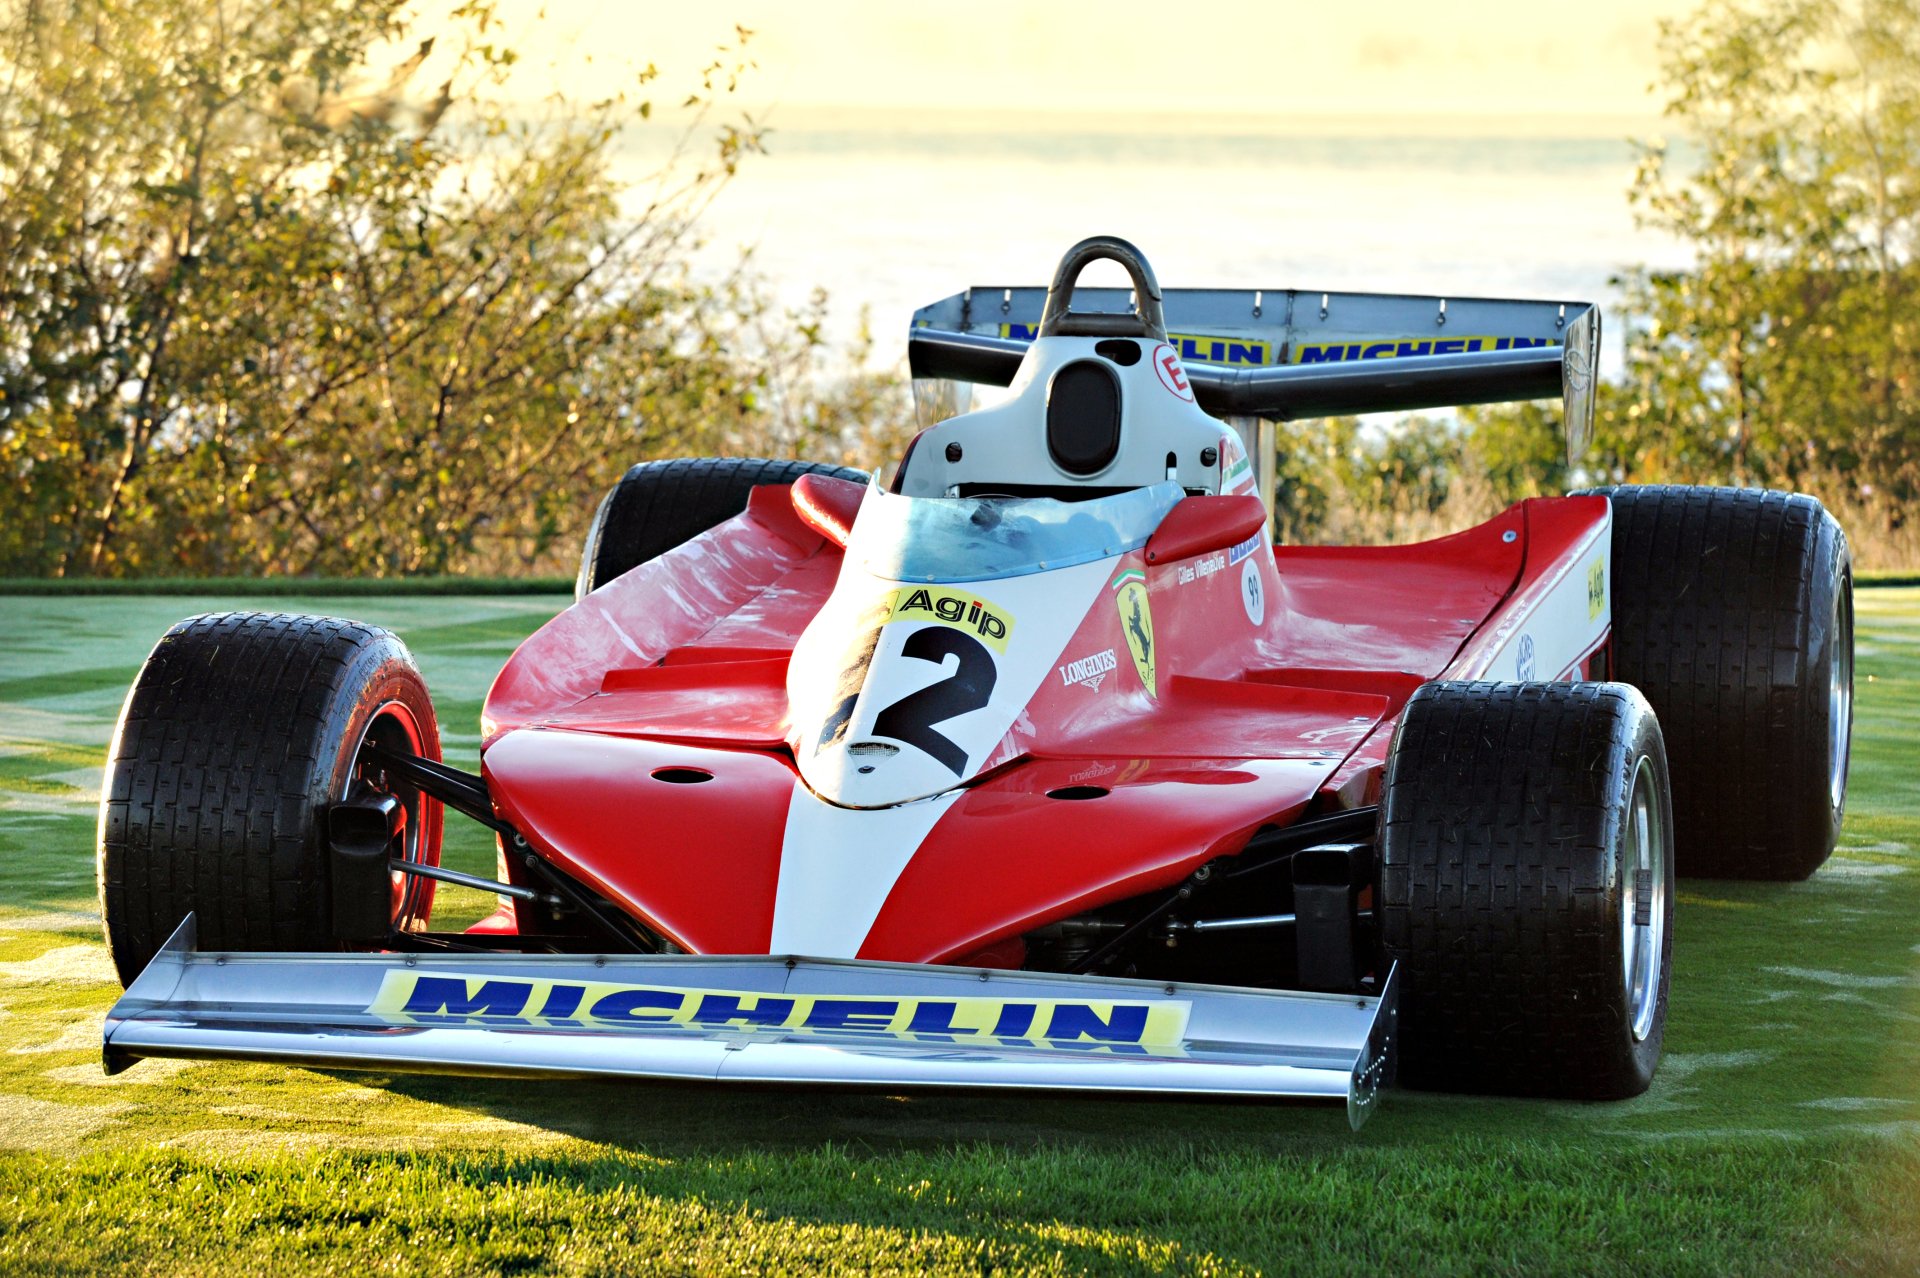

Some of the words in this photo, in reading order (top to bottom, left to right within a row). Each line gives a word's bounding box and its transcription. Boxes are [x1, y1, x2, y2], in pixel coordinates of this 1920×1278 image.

[1162, 355, 1188, 391] E
[1248, 573, 1259, 607] 99
[899, 589, 1006, 640] Agip
[1059, 648, 1117, 686] LONGINES
[871, 625, 997, 779] 2
[400, 977, 1149, 1042] MICHELIN
